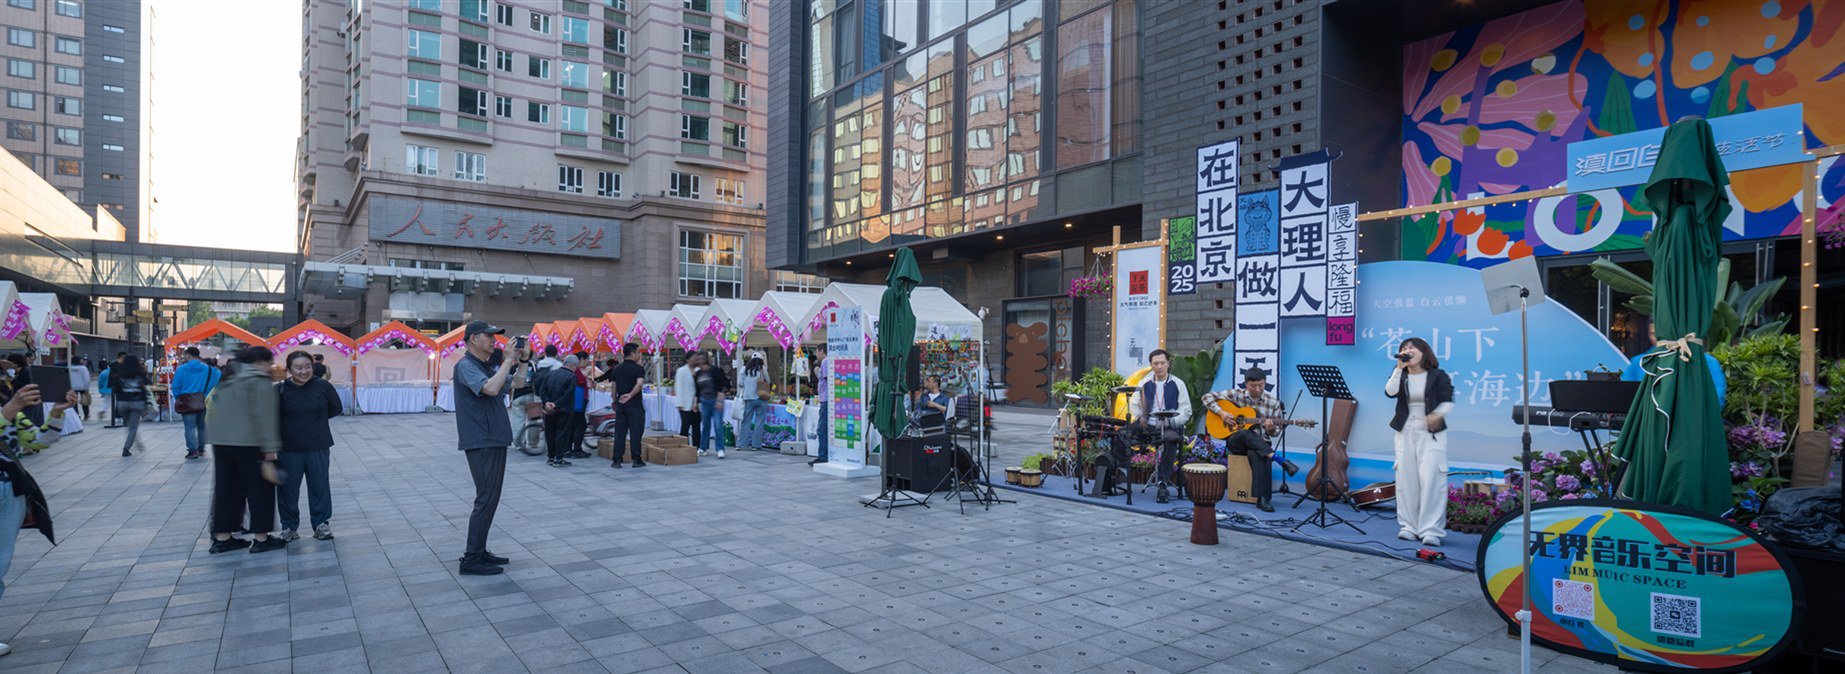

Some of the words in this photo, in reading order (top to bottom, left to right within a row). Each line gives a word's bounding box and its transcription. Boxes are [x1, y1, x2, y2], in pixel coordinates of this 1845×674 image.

[386, 203, 604, 250] 人民出版社
[1200, 148, 1235, 277] 在北京
[1283, 170, 1325, 312] 大理人
[1329, 206, 1353, 314] 慢享隆福
[1171, 265, 1194, 279] 20
[1171, 279, 1194, 293] 25
[1238, 261, 1277, 392] 做一天
[1329, 322, 1353, 333] long
[1330, 331, 1342, 341] fu
[1529, 530, 1737, 579] 无界音乐空间
[1564, 565, 1588, 577] LIM
[1633, 574, 1687, 589] SPACE
